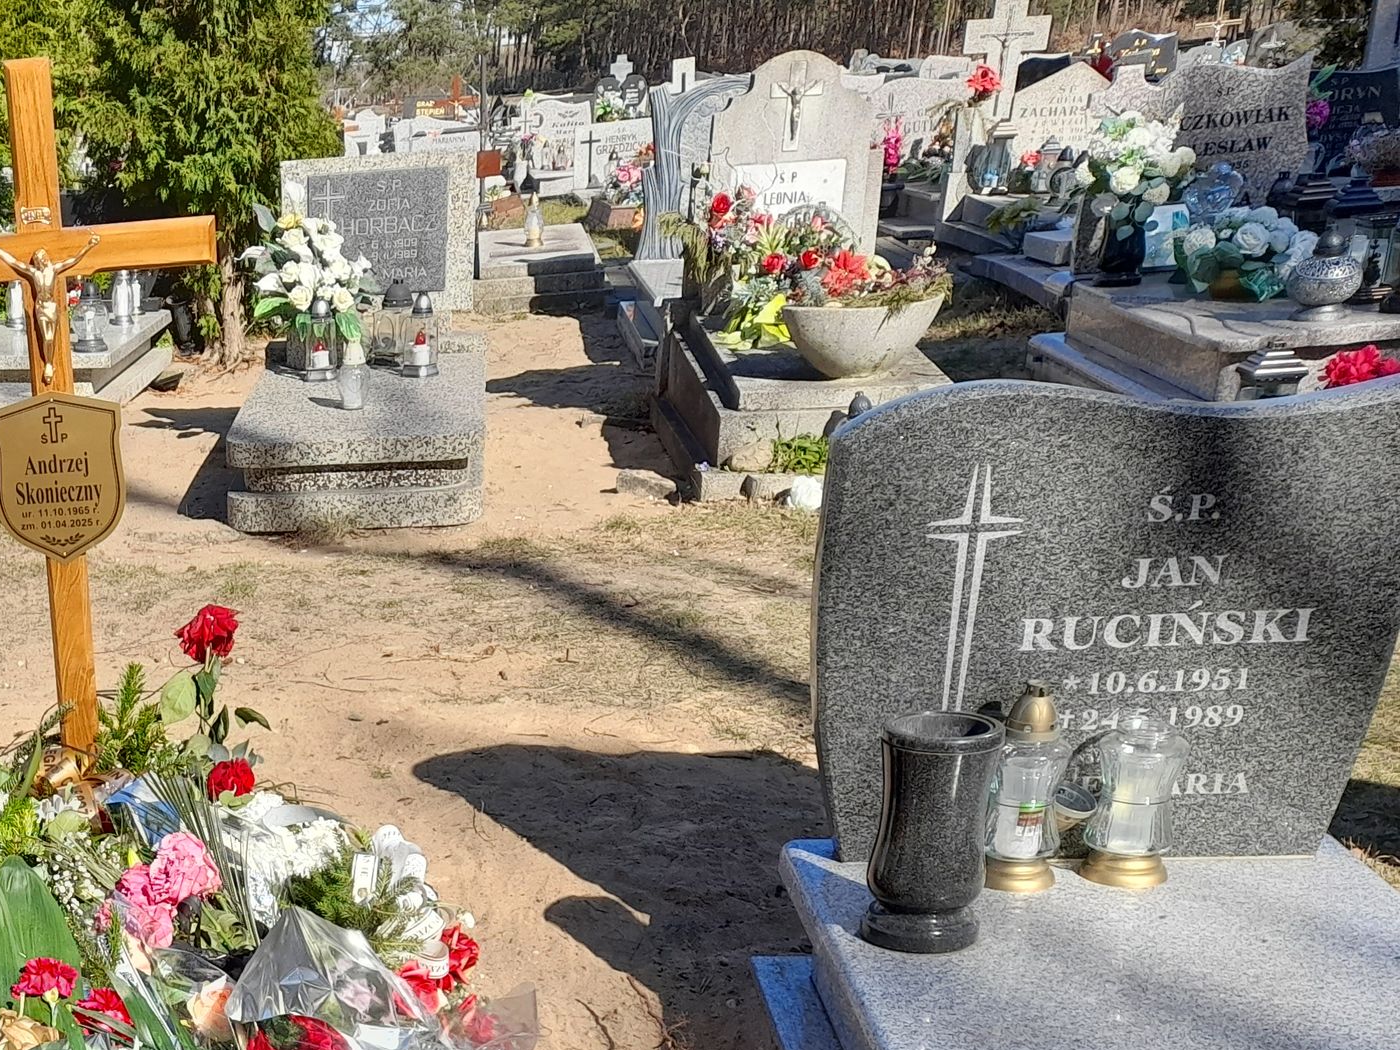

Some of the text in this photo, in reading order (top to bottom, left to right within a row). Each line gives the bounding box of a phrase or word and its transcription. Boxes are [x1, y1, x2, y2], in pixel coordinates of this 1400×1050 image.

[25, 451, 90, 478] Andrzej
[15, 480, 102, 508] Skonieczny
[1147, 487, 1221, 523] Ś.P.
[21, 510, 35, 519] ur.
[39, 506, 90, 518] 11.10.1965
[21, 522, 39, 531] zm.
[41, 517, 94, 529] 01.04.2025
[1121, 554, 1228, 589] JAN
[1018, 600, 1318, 652] RUCIŃSKI
